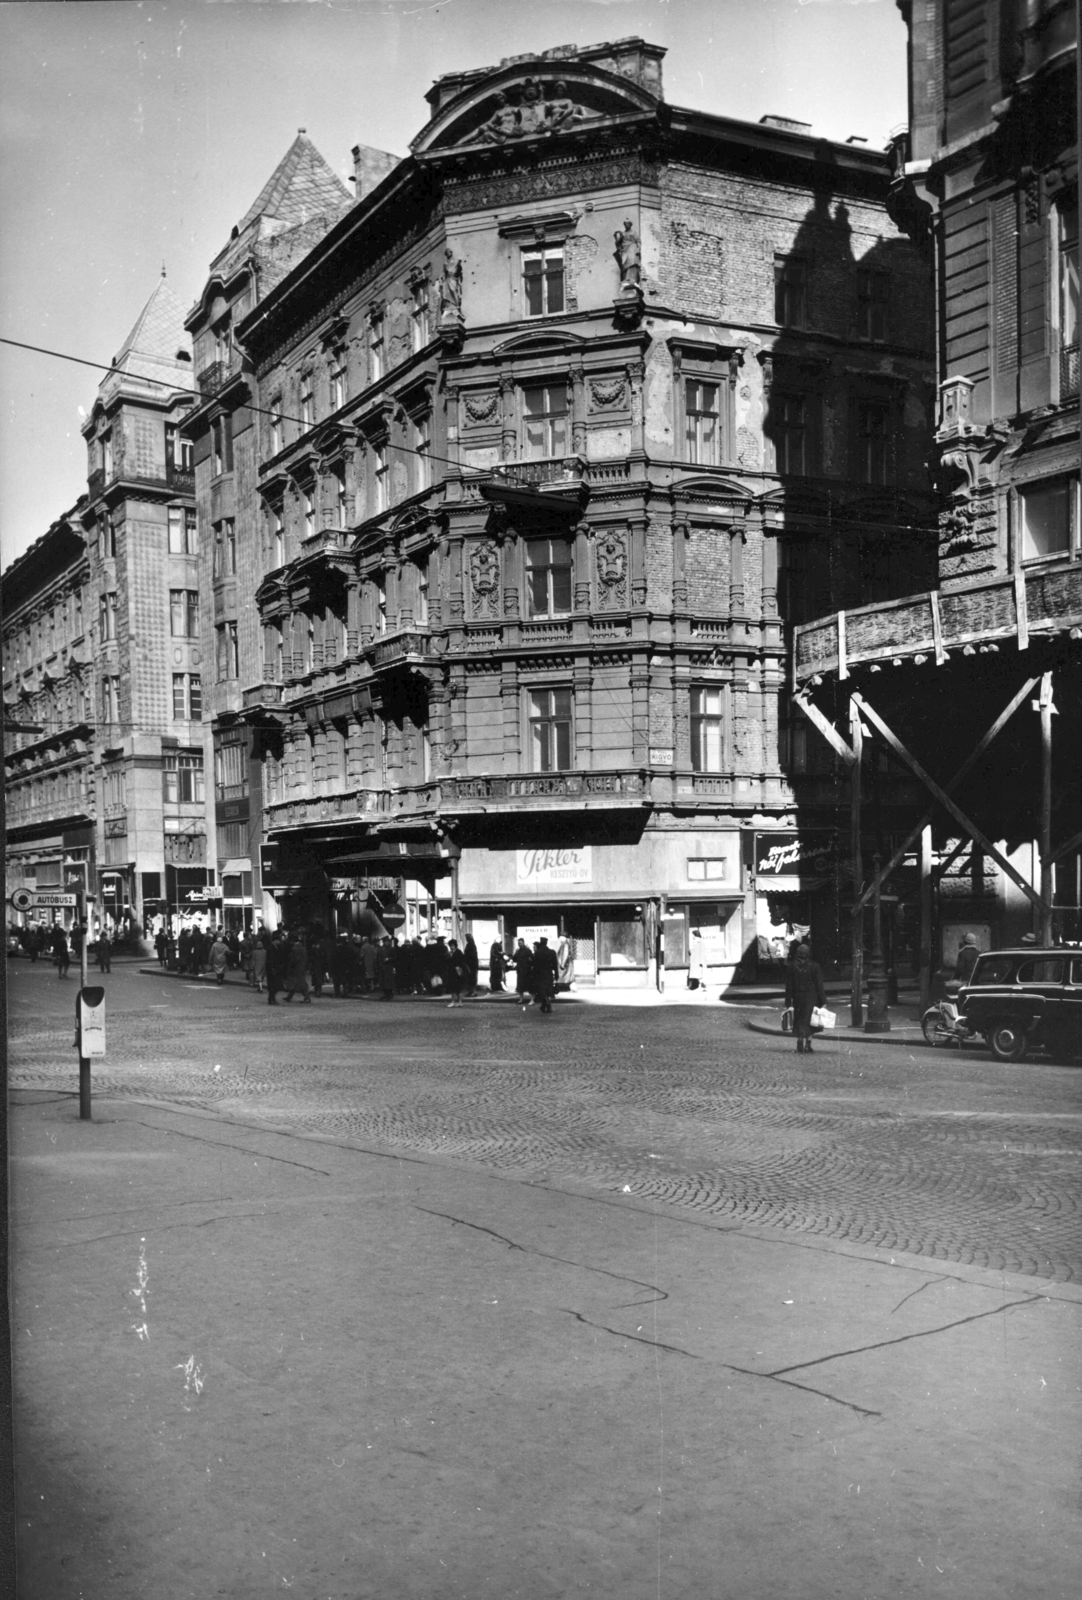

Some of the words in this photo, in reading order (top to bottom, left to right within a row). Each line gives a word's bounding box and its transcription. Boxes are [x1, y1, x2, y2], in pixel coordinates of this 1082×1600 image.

[518, 849, 582, 880] Pikler
[550, 867, 577, 879] KESZTYŰ
[37, 895, 73, 904] AUTÓBUSZ
